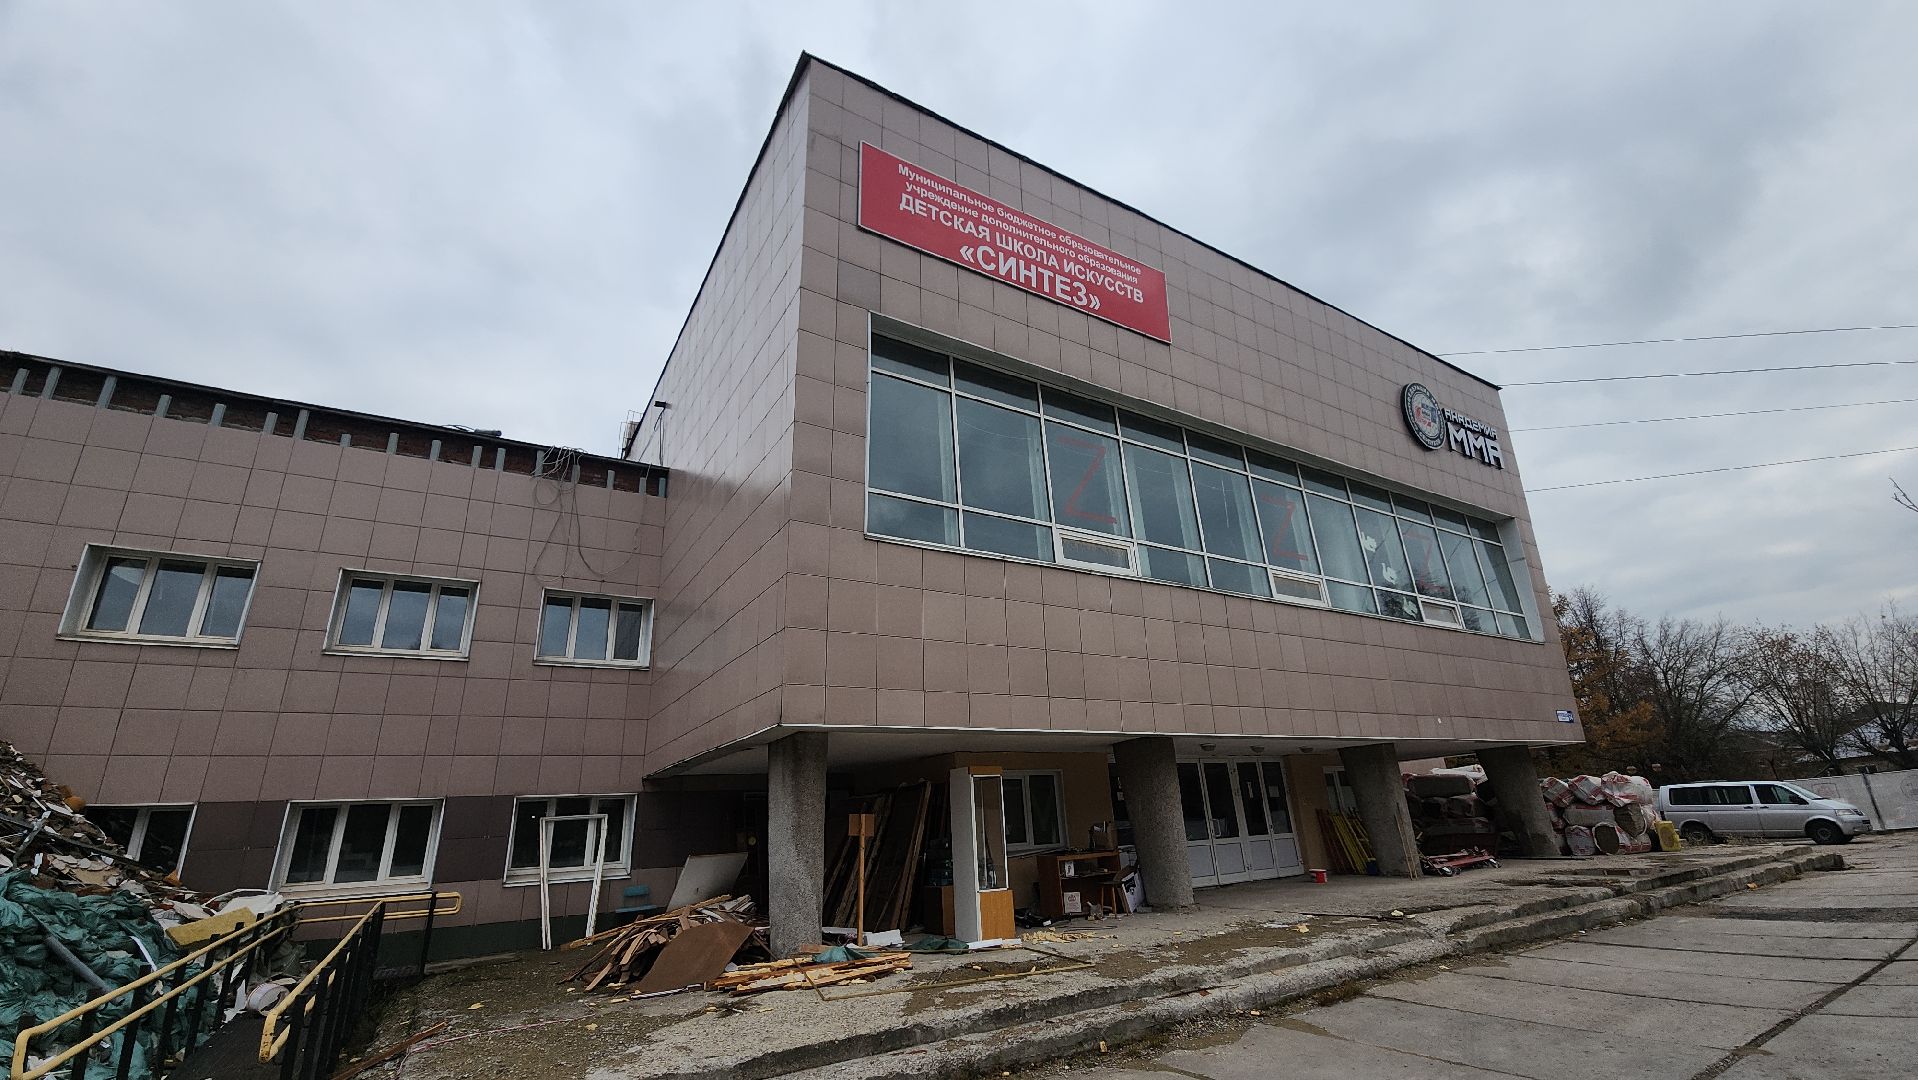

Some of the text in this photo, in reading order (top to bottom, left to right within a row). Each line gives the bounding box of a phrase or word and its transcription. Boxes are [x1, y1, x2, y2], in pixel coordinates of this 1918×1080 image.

[898, 163, 1142, 275] Муниципальное бюджетное образовательное
[899, 193, 1144, 303] ДЕТСКАЯ ШКОЛА ИСКУССТВ
[905, 181, 1138, 284] учреждение дополнительного образования
[960, 245, 1101, 311] «СИНТЕЗ»
[1445, 409, 1498, 439] АКАДЕМИЯ
[1446, 422, 1505, 469] ММА
[1056, 434, 1117, 524] Z
[1261, 493, 1308, 561] Z
